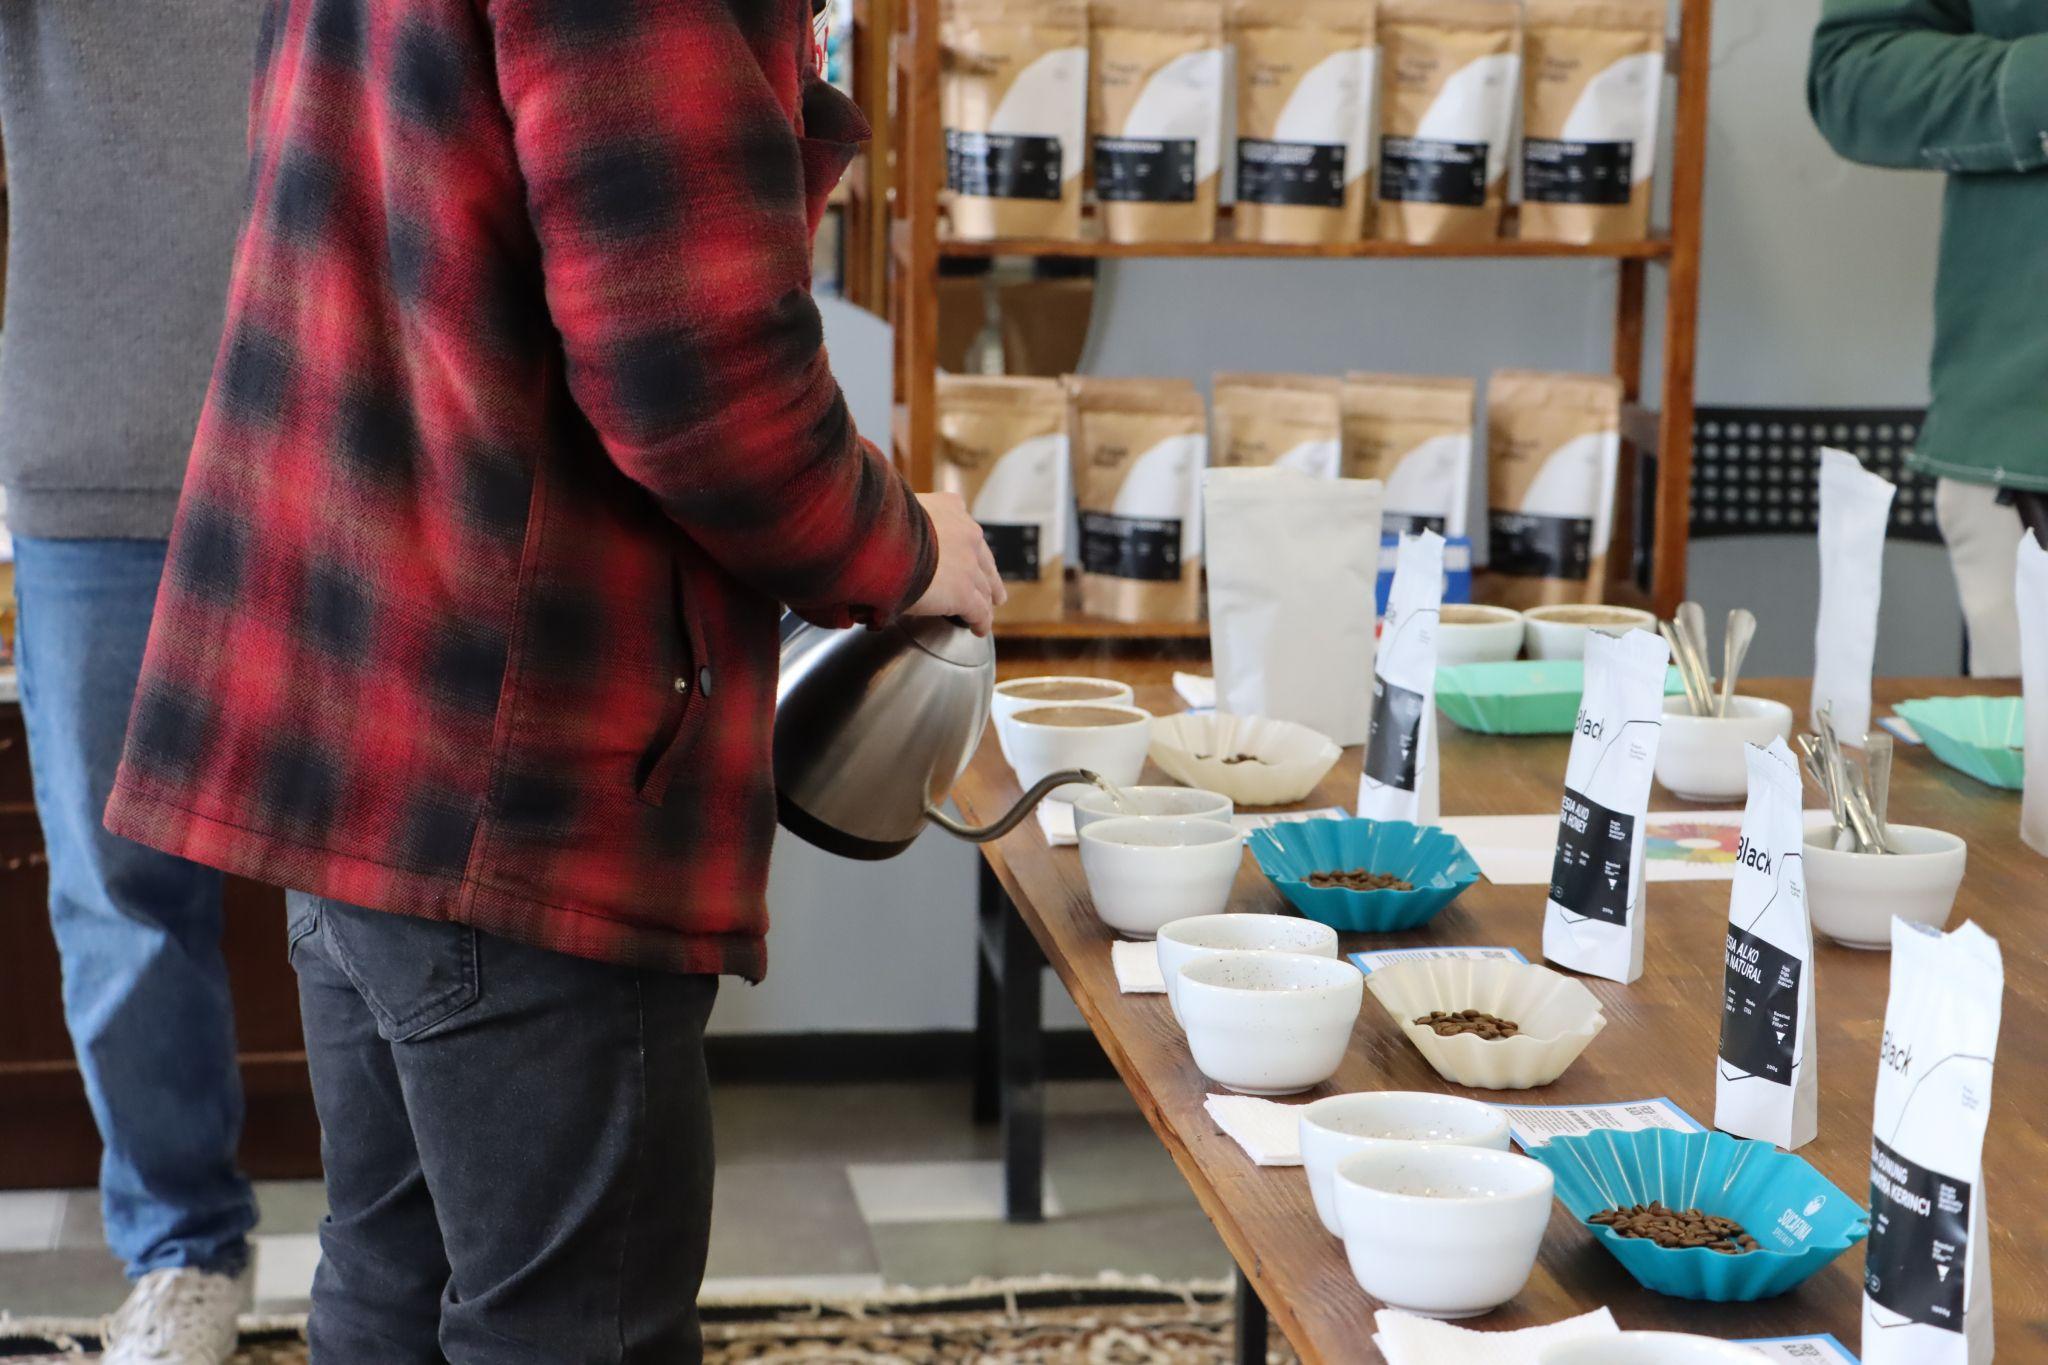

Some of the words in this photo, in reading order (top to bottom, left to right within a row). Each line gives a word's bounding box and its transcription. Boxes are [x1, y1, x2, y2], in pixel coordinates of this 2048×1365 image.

[1736, 943, 1760, 964] ALKO
[1729, 955, 1762, 984] NATURAL
[1881, 1030, 1912, 1077] Black
[1777, 1208, 1813, 1242] SUCAFINA
